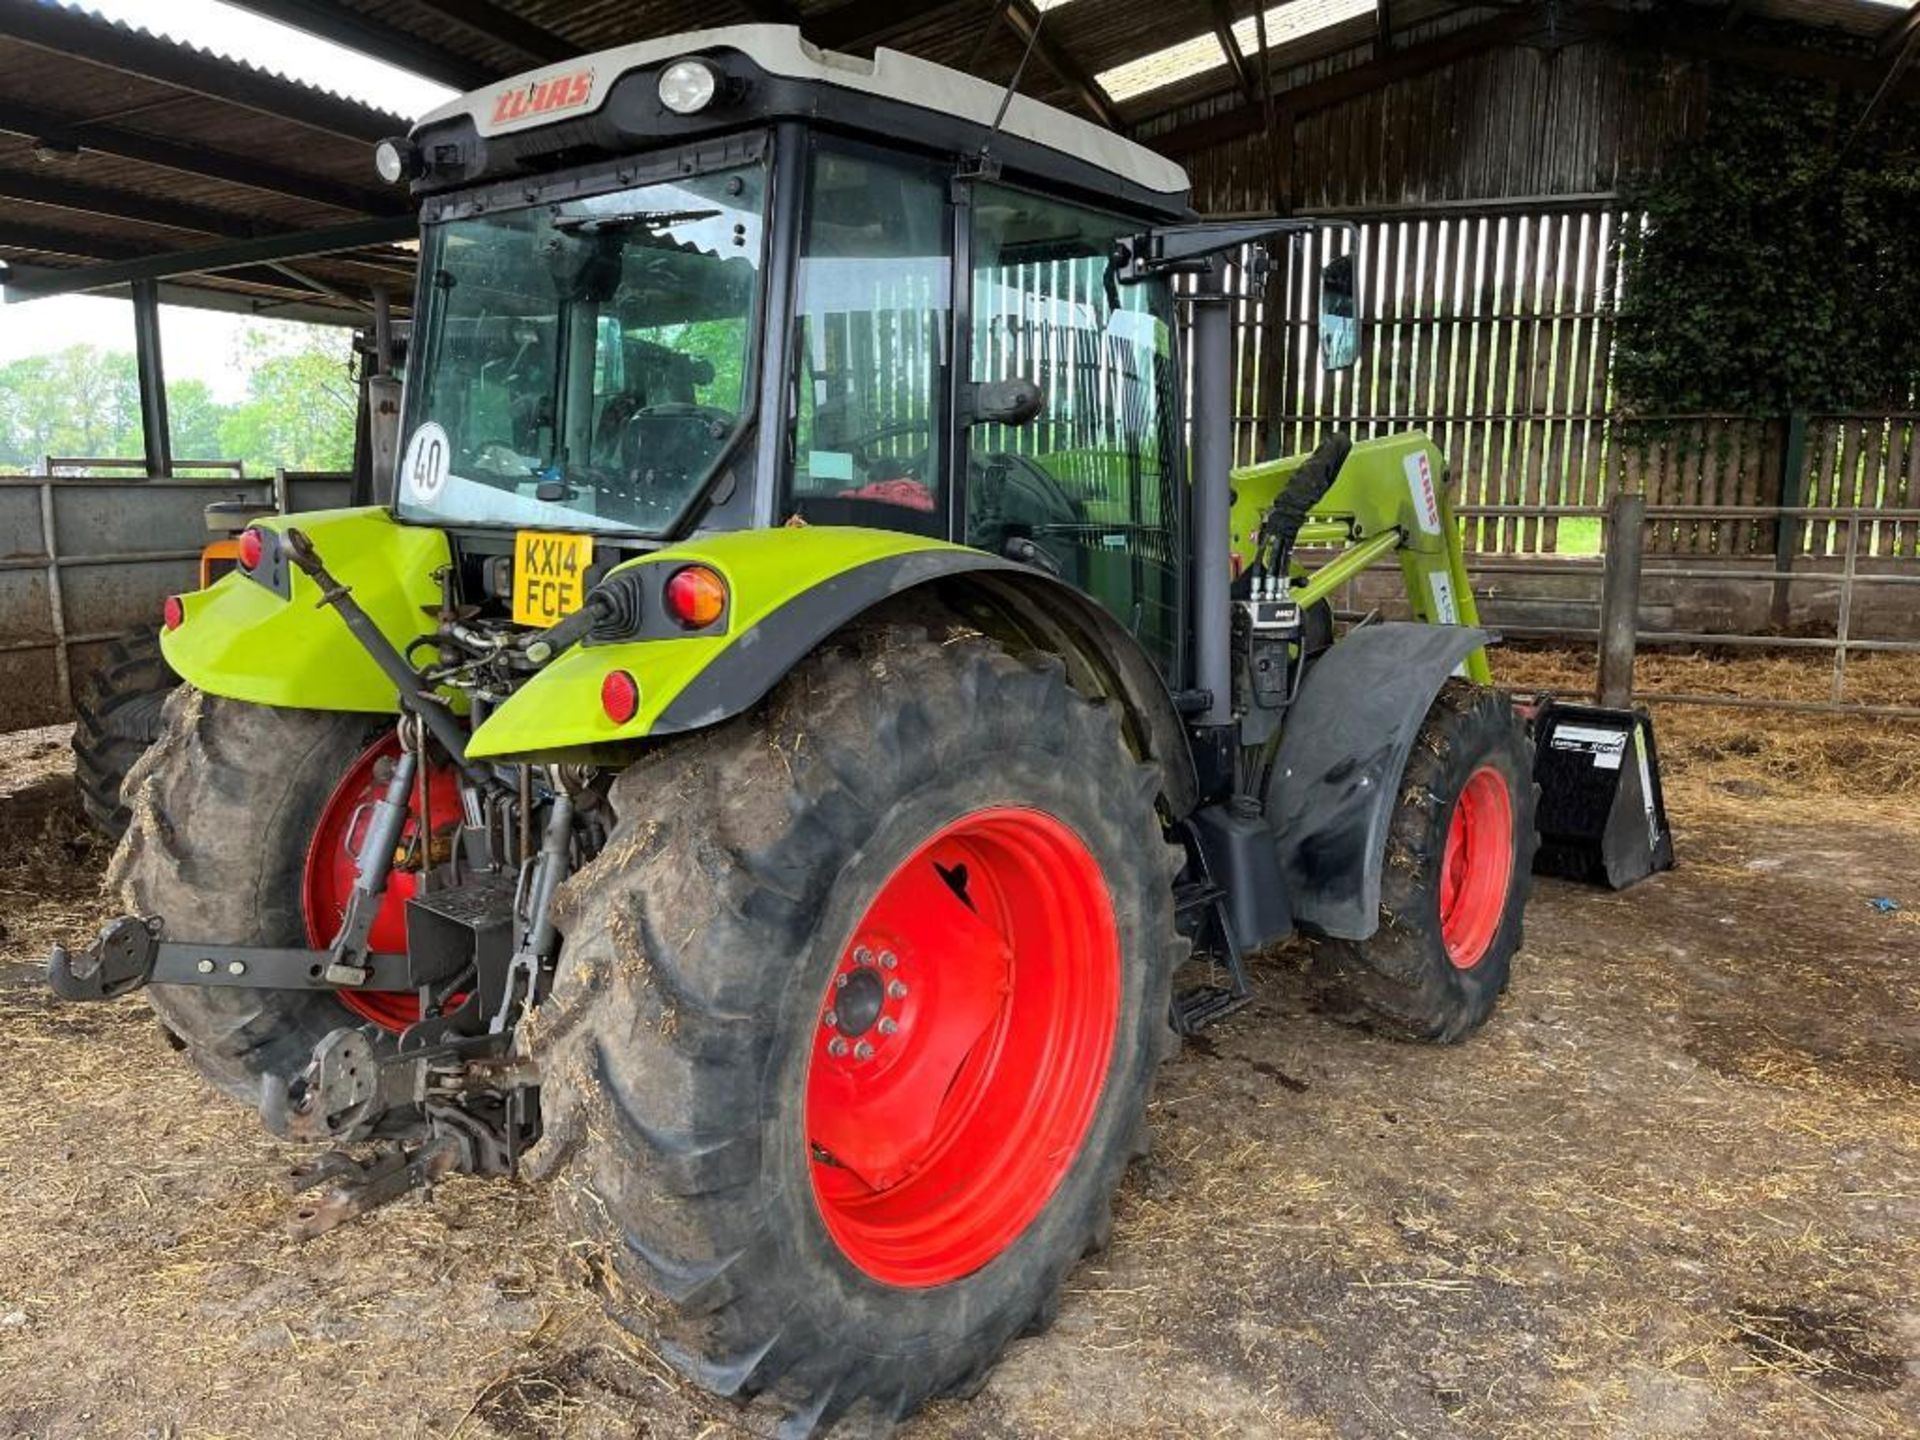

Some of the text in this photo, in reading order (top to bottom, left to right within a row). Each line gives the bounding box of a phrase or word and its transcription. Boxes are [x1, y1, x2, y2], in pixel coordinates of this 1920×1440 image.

[413, 438, 441, 490] 40
[526, 540, 577, 578] KX14
[526, 579, 573, 617] FCE
